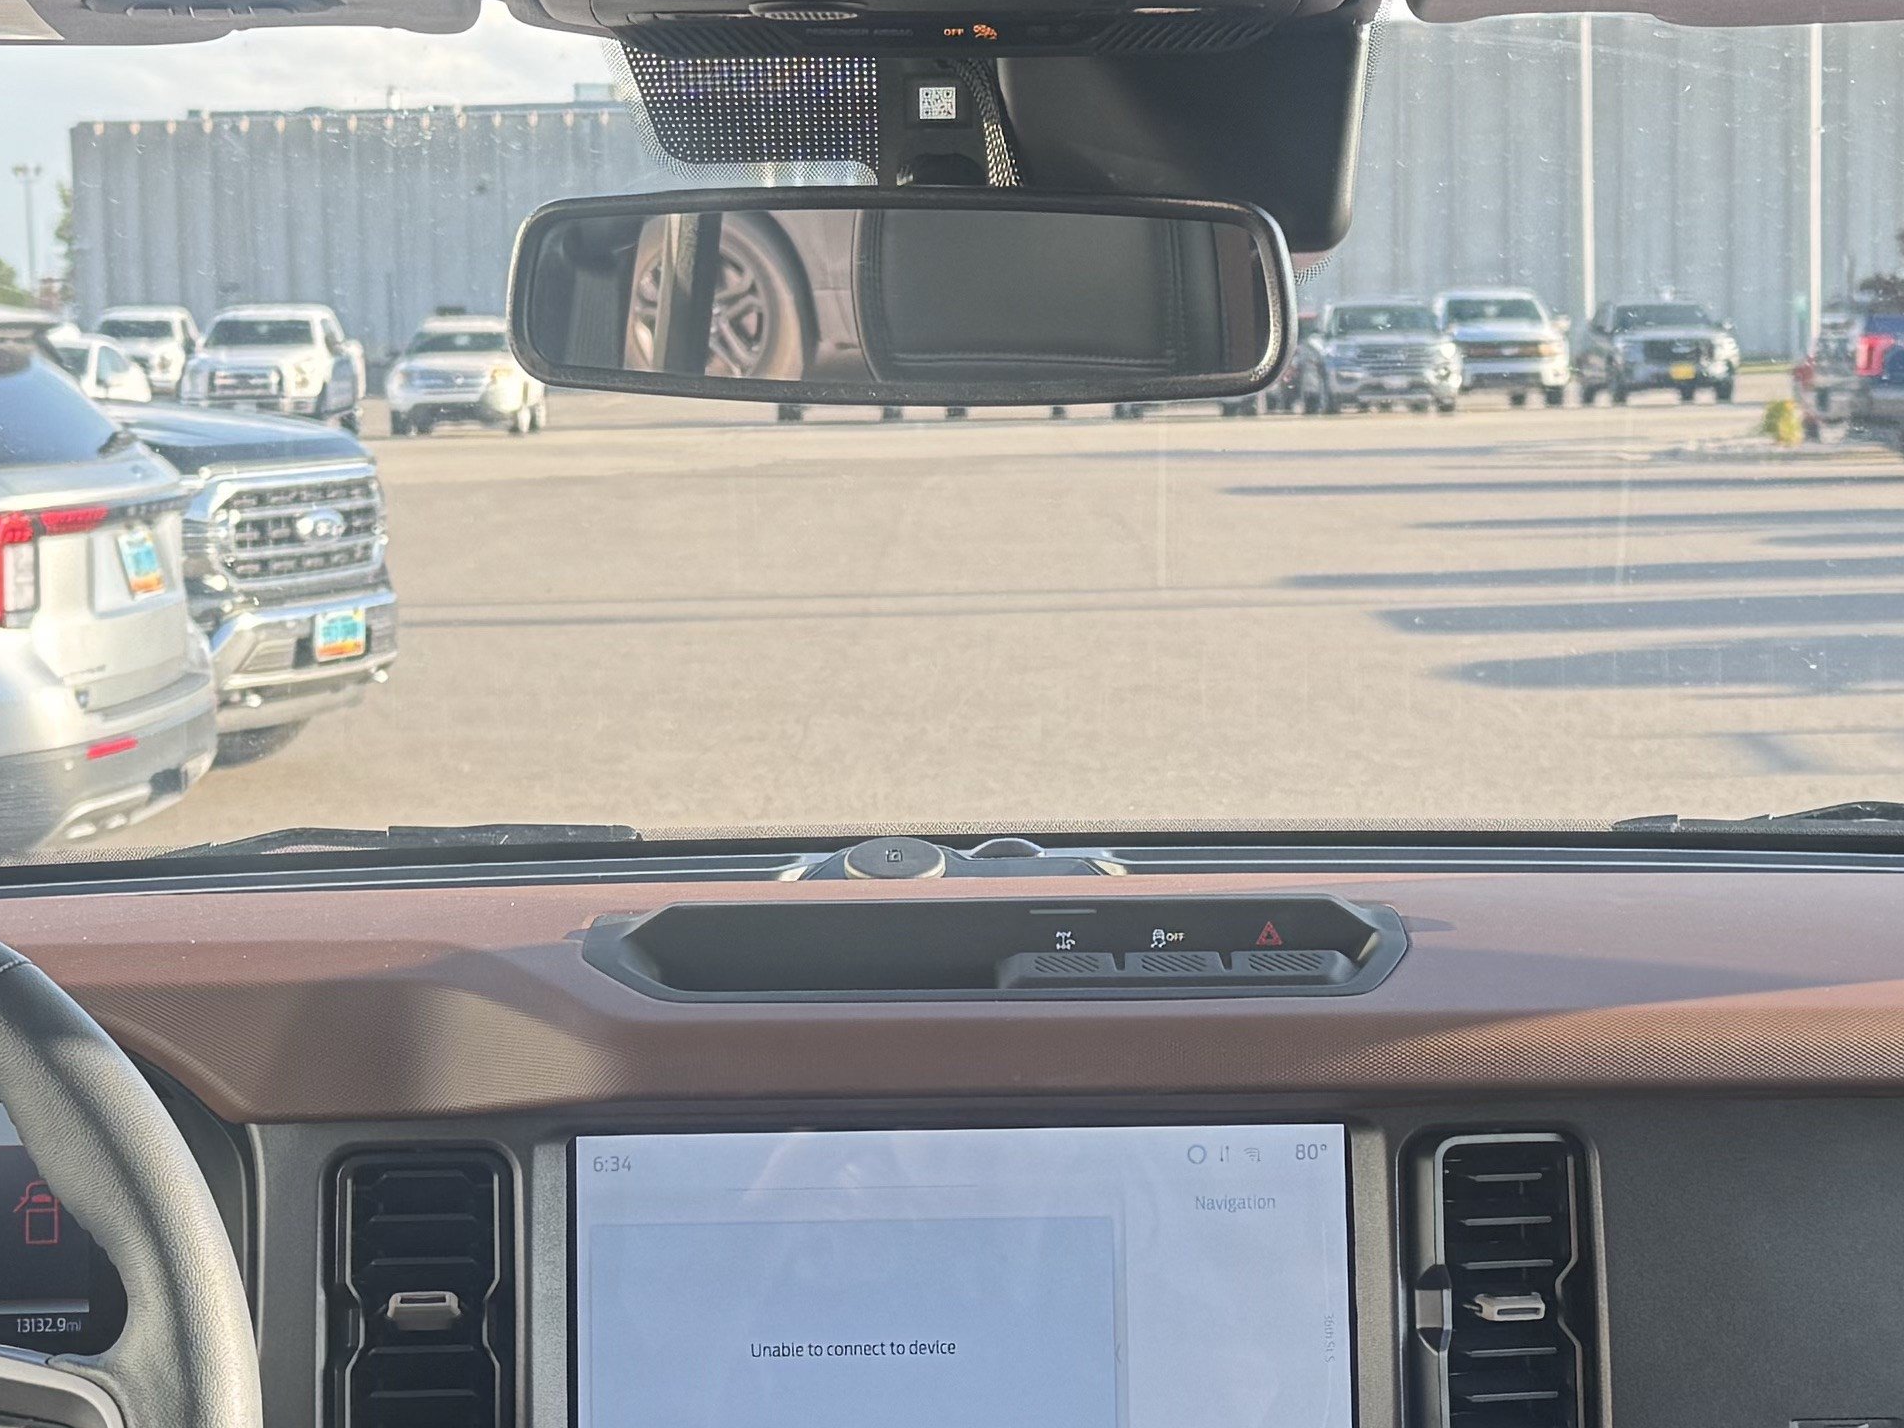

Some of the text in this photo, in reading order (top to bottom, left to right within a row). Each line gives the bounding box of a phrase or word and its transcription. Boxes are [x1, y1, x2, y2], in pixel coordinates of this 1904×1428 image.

[943, 28, 964, 37] OFF
[592, 1155, 632, 1173] 6:34
[1195, 1195, 1276, 1213] Navigation
[750, 1340, 956, 1358] Unable to connect to device
